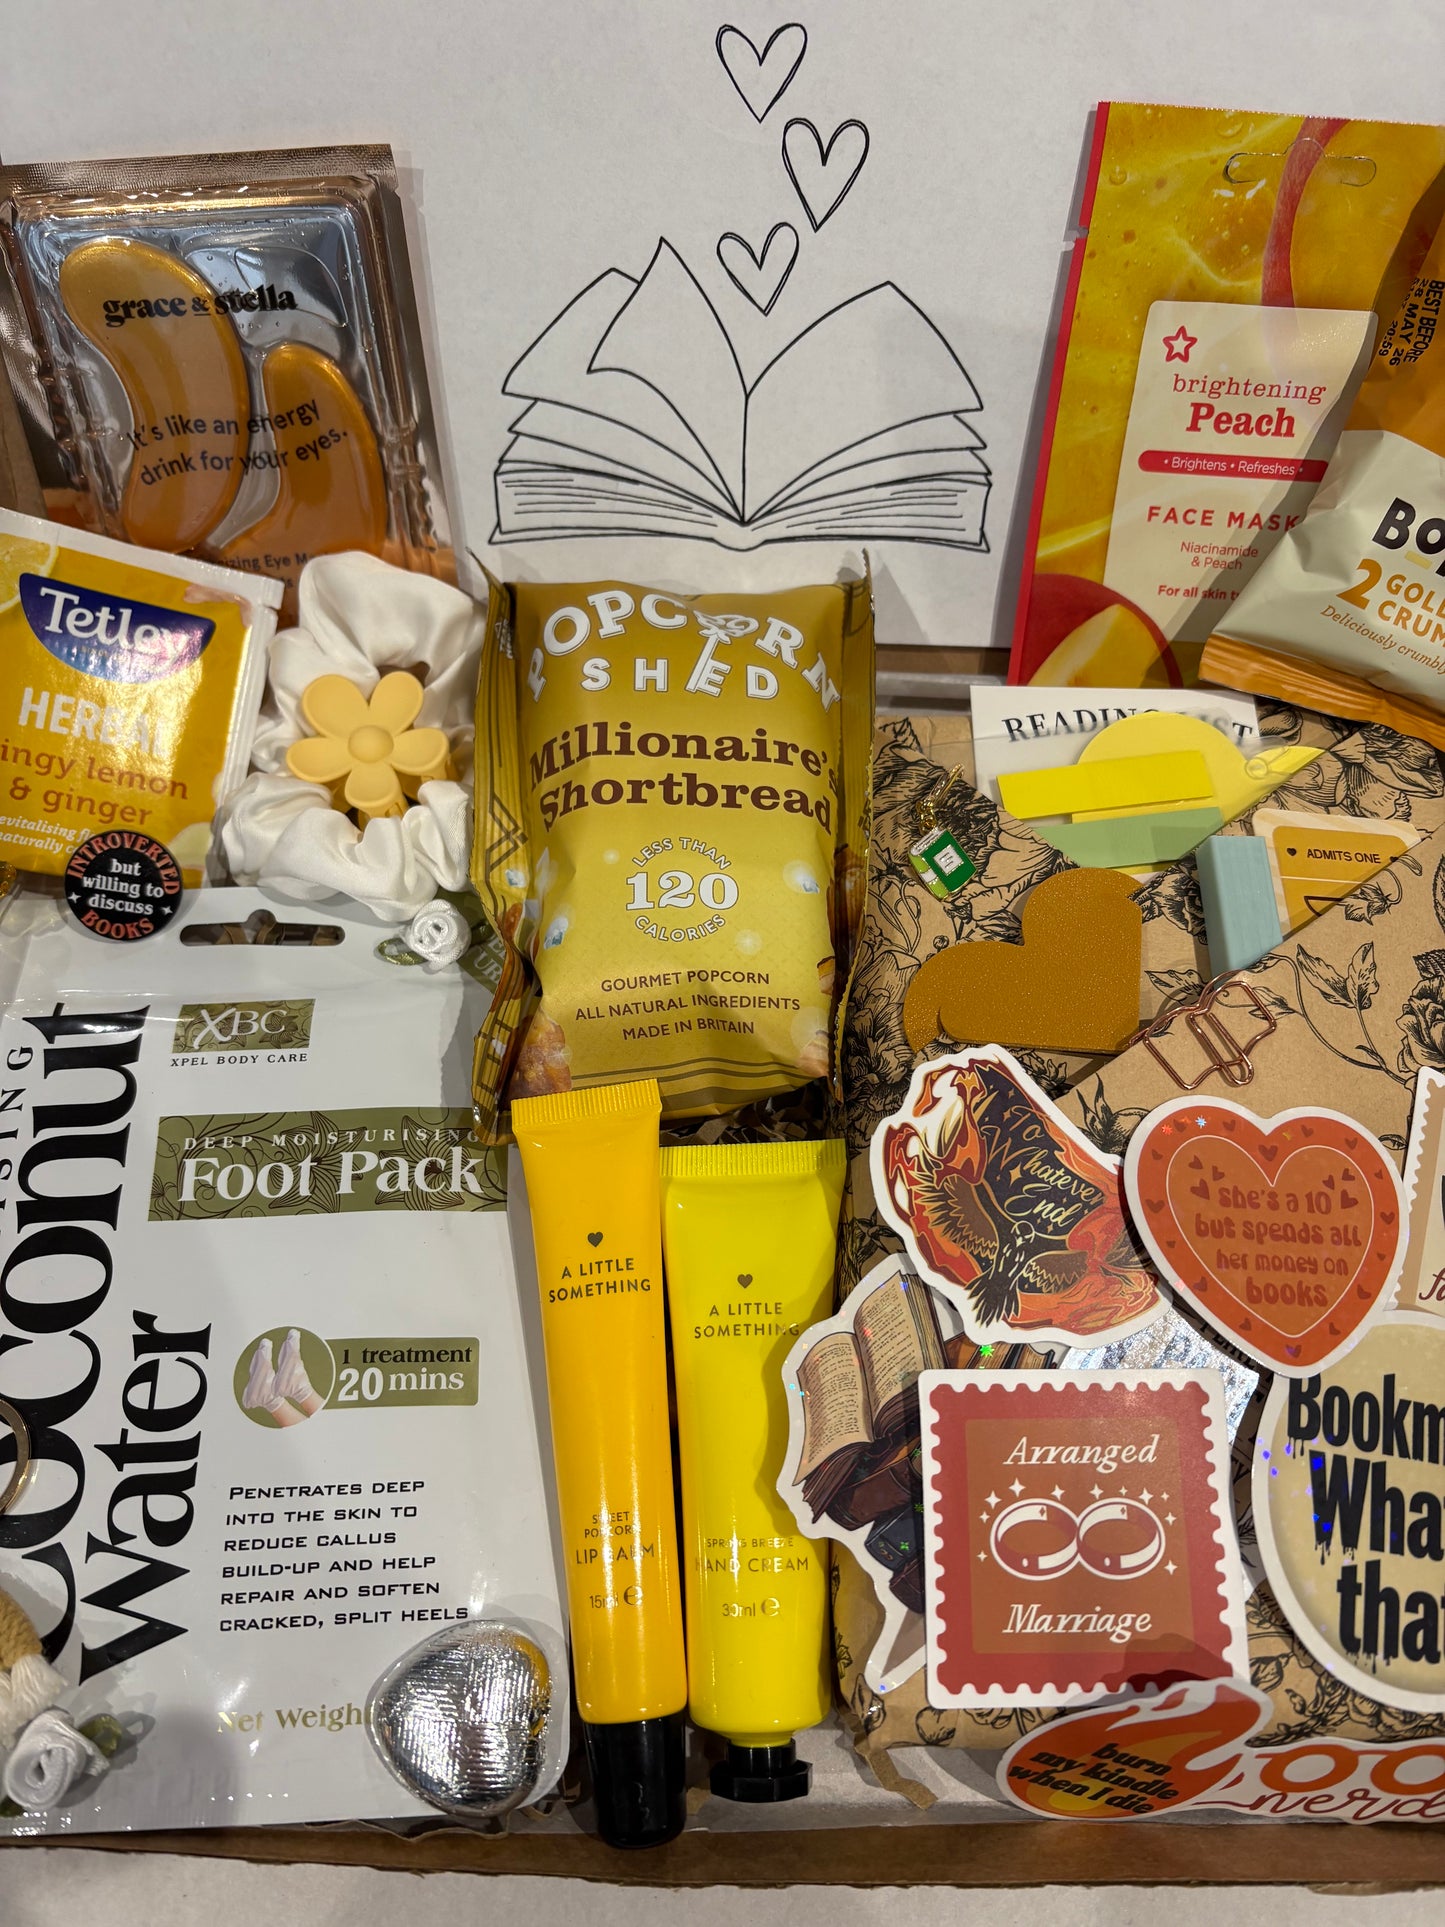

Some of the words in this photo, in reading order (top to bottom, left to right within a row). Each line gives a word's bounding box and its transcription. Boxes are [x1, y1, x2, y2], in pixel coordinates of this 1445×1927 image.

[102, 299, 187, 328] grace
[191, 298, 211, 316] &
[215, 284, 298, 315] stella
[1421, 279, 1445, 315] BEST
[1378, 320, 1398, 356] 20:59
[1399, 303, 1419, 345] MAY
[1403, 317, 1437, 363] BEFORE
[1389, 348, 1404, 366] 26
[1173, 374, 1327, 405] brightening
[165, 414, 206, 437] like
[213, 418, 239, 435] an
[246, 399, 320, 433] energy
[1186, 402, 1295, 438] Peach
[140, 452, 200, 486] drink
[200, 451, 233, 471] for
[239, 452, 288, 476] your
[295, 430, 348, 462] eyes.
[1171, 456, 1227, 473] Brightens
[1238, 460, 1295, 475] Refreshes
[1147, 506, 1215, 526] FACE
[1227, 511, 1300, 532] MASK
[1180, 541, 1259, 558] Niacinamide
[1372, 497, 1445, 577] Bo
[263, 554, 291, 570] Eye
[1191, 556, 1200, 567] &
[1204, 556, 1242, 570] Peach
[1158, 585, 1180, 598] For
[1183, 587, 1198, 599] all
[1201, 588, 1228, 601] skin
[1336, 558, 1382, 610] 2
[40, 587, 191, 666] Tetley
[1320, 605, 1397, 650] Deliciously
[527, 589, 842, 713] POPCORN
[580, 654, 779, 700] SHED
[529, 721, 839, 797] Millionaire's
[87, 756, 188, 799] lemon
[9, 777, 31, 800] &
[42, 788, 153, 825] ginger
[540, 772, 832, 837] Shortbread
[66, 832, 180, 895] INTROVERTED
[111, 858, 141, 876] but
[632, 837, 673, 867] LESS
[679, 836, 731, 870] THAN
[1306, 848, 1352, 862] ADMITS
[1354, 852, 1381, 864] ONE
[82, 874, 141, 899] willing
[145, 883, 165, 898] to
[626, 870, 739, 911] 120
[88, 893, 154, 915] discuss
[81, 909, 154, 938] BOOKS
[635, 914, 726, 942] CALORIES
[601, 972, 682, 992] GOURMET
[687, 970, 769, 985] POPCORN
[575, 1006, 605, 1020] ALL
[609, 997, 688, 1017] NATURAL
[692, 994, 800, 1010] INGREDIENTS
[193, 1006, 289, 1049] XBC
[623, 1023, 670, 1040] MADE
[674, 1021, 692, 1034] IN
[698, 1018, 754, 1034] BRITAIN
[171, 1057, 209, 1067] XPEL
[217, 1055, 260, 1065] BODY
[267, 1053, 308, 1063] CARE
[1009, 1105, 1047, 1141] To
[184, 1136, 254, 1151] DEEP
[271, 1128, 480, 1147] MOISTURISING
[178, 1153, 318, 1202] Foot
[336, 1146, 485, 1194] Pack
[980, 1125, 1106, 1205] Whatever
[1004, 1182, 1082, 1227] End
[1218, 1185, 1280, 1211] she's
[1286, 1193, 1299, 1213] a
[1305, 1191, 1332, 1215] 10
[1195, 1213, 1236, 1239] but
[1242, 1220, 1323, 1245] spends
[1330, 1224, 1362, 1247] all
[561, 1265, 572, 1280] A
[580, 1257, 635, 1276] LITTLE
[1216, 1248, 1248, 1270] her
[1255, 1253, 1319, 1275] money
[1323, 1257, 1349, 1276] on
[549, 1278, 651, 1303] SOMETHING
[1246, 1276, 1328, 1307] books
[709, 1304, 720, 1317] A
[728, 1302, 782, 1316] LITTLE
[694, 1323, 800, 1339] SOMETHING
[362, 1346, 473, 1364] treatment
[338, 1366, 384, 1401] 20
[389, 1367, 465, 1391] mins
[1003, 1434, 1160, 1474] Arranged
[79, 1310, 211, 1686] Water
[371, 1480, 425, 1495] DEEP
[226, 1511, 275, 1526] INTO
[284, 1509, 324, 1523] THE
[334, 1506, 381, 1520] SKIN
[391, 1505, 417, 1518] TO
[1309, 1449, 1445, 1564] Wha
[223, 1535, 307, 1552] REDUCE
[317, 1532, 396, 1548] CALLUS
[576, 1548, 598, 1564] LIP
[222, 1561, 320, 1579] BUILD-UP
[329, 1558, 373, 1573] AND
[382, 1555, 436, 1569] HELP
[748, 1556, 809, 1573] CREAM
[220, 1590, 294, 1606] REPAIR
[303, 1586, 348, 1600] AND
[358, 1582, 440, 1597] SOFTEN
[722, 1602, 755, 1617] 30ml
[219, 1613, 324, 1632] CRACKED,
[334, 1610, 392, 1626] SPLIT
[401, 1606, 468, 1622] HEELS
[1002, 1603, 1153, 1643] Marriage
[1337, 1559, 1445, 1668] tha
[217, 1711, 263, 1734] Net
[1092, 1743, 1172, 1776] burn
[1009, 1766, 1090, 1796] when
[1087, 1787, 1114, 1801] I
[1105, 1794, 1155, 1814] die
[1029, 1752, 1087, 1773] my
[1081, 1763, 1179, 1800] kindle
